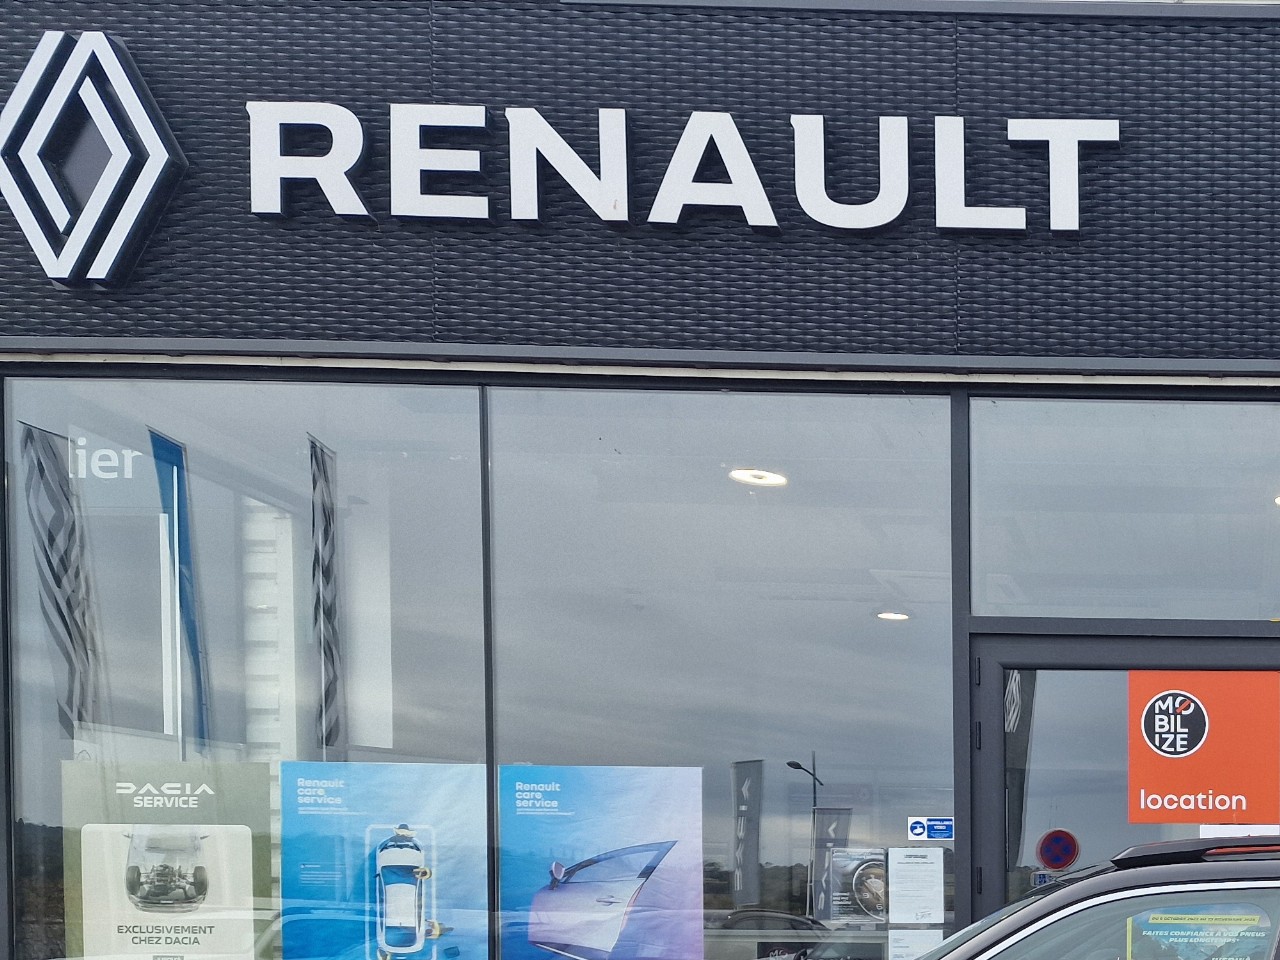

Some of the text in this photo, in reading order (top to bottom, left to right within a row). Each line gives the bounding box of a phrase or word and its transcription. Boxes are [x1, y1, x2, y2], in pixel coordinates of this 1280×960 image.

[246, 100, 1120, 231] RENAULT
[68, 437, 142, 479] ier
[1154, 714, 1189, 733] BIL
[1155, 733, 1188, 752] IZE
[297, 778, 345, 788] Renault
[515, 782, 561, 791] Renault
[116, 782, 215, 795] DACIA
[297, 788, 325, 796] care
[297, 795, 342, 804] service
[515, 791, 542, 799] care
[1140, 788, 1247, 811] location
[134, 797, 198, 808] SERVICE
[515, 798, 558, 807] service
[117, 925, 215, 934] EXCLUSIVEMENT
[131, 936, 201, 945] CHEZ DACIA
